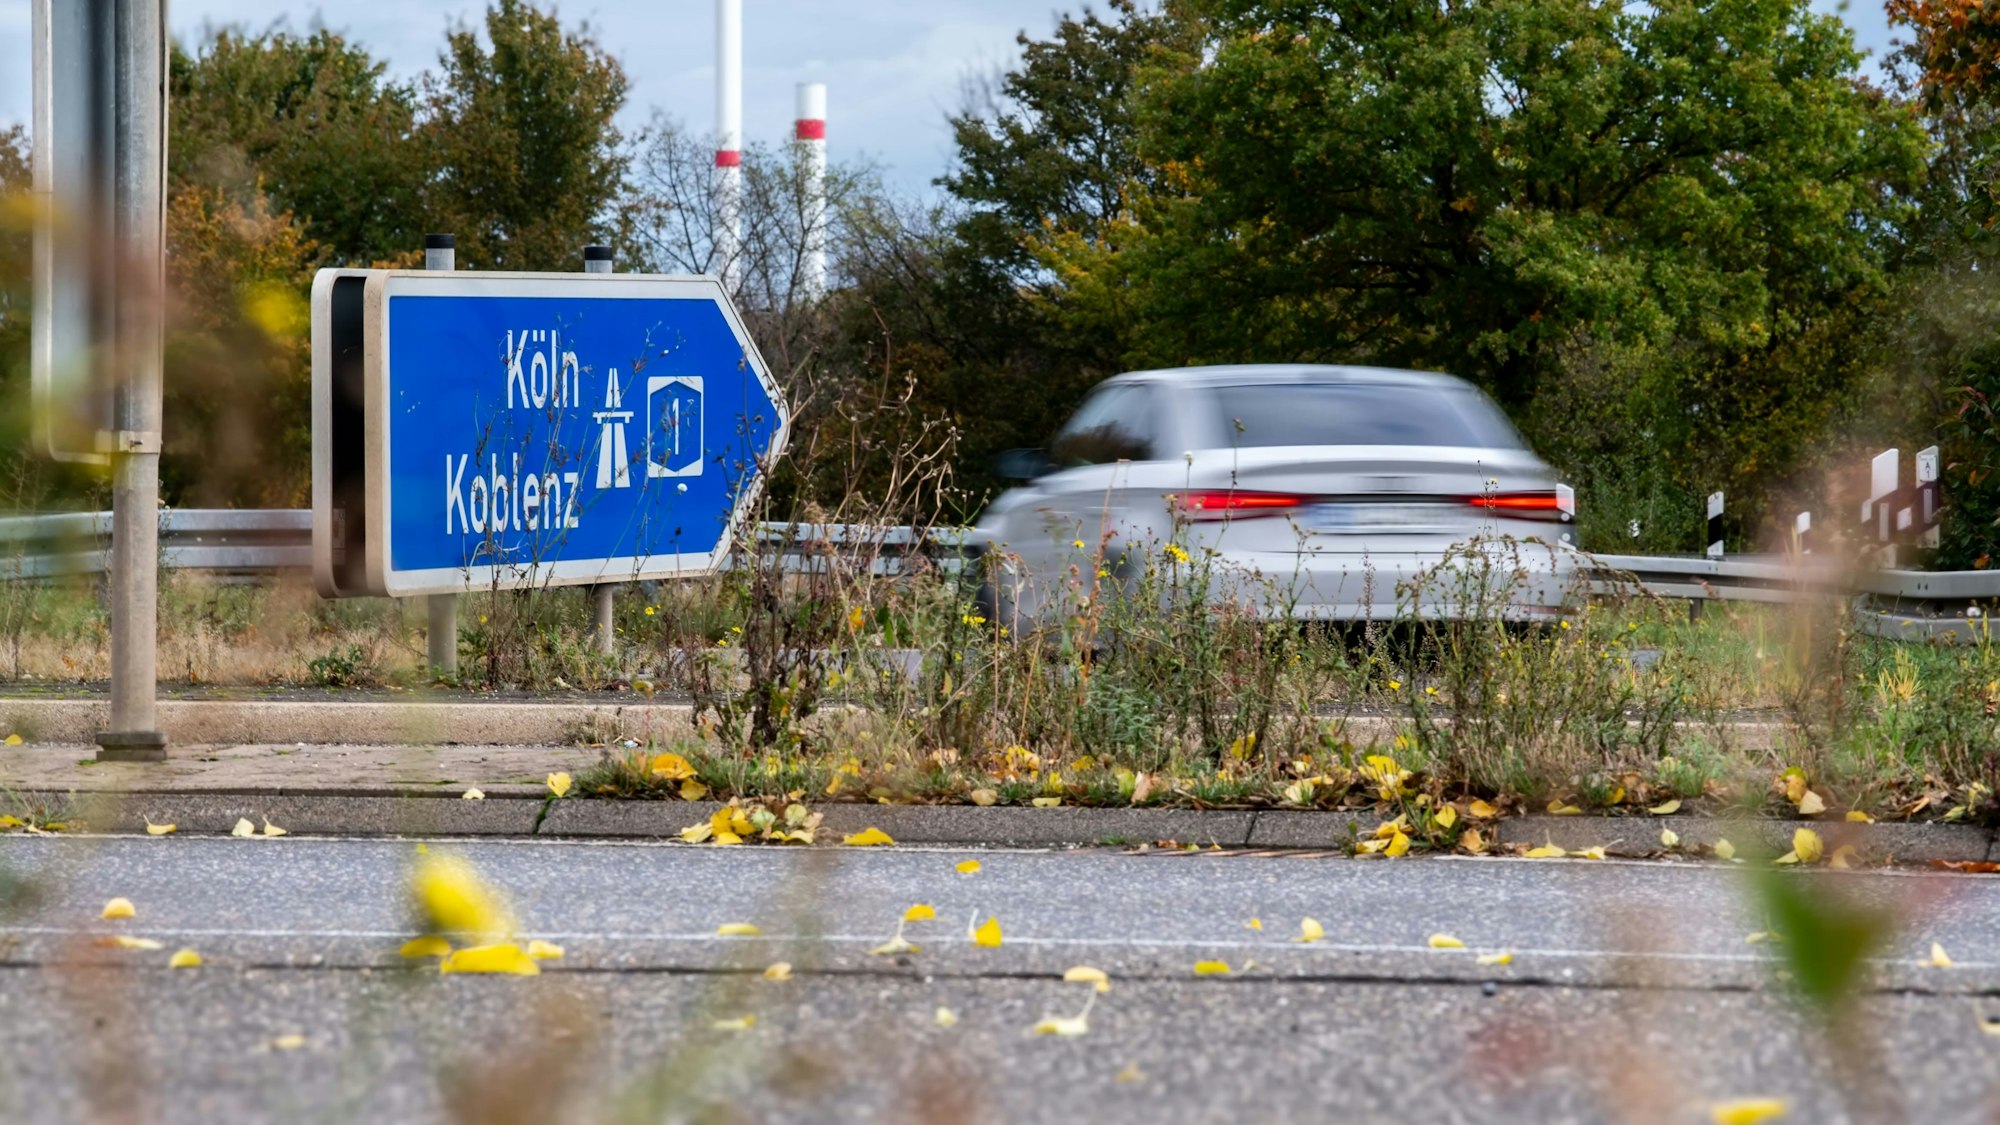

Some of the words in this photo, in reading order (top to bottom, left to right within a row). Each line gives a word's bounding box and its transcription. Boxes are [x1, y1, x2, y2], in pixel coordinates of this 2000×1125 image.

[507, 329, 579, 409] Köln
[672, 398, 679, 455] 1
[446, 452, 579, 534] Koblenz
